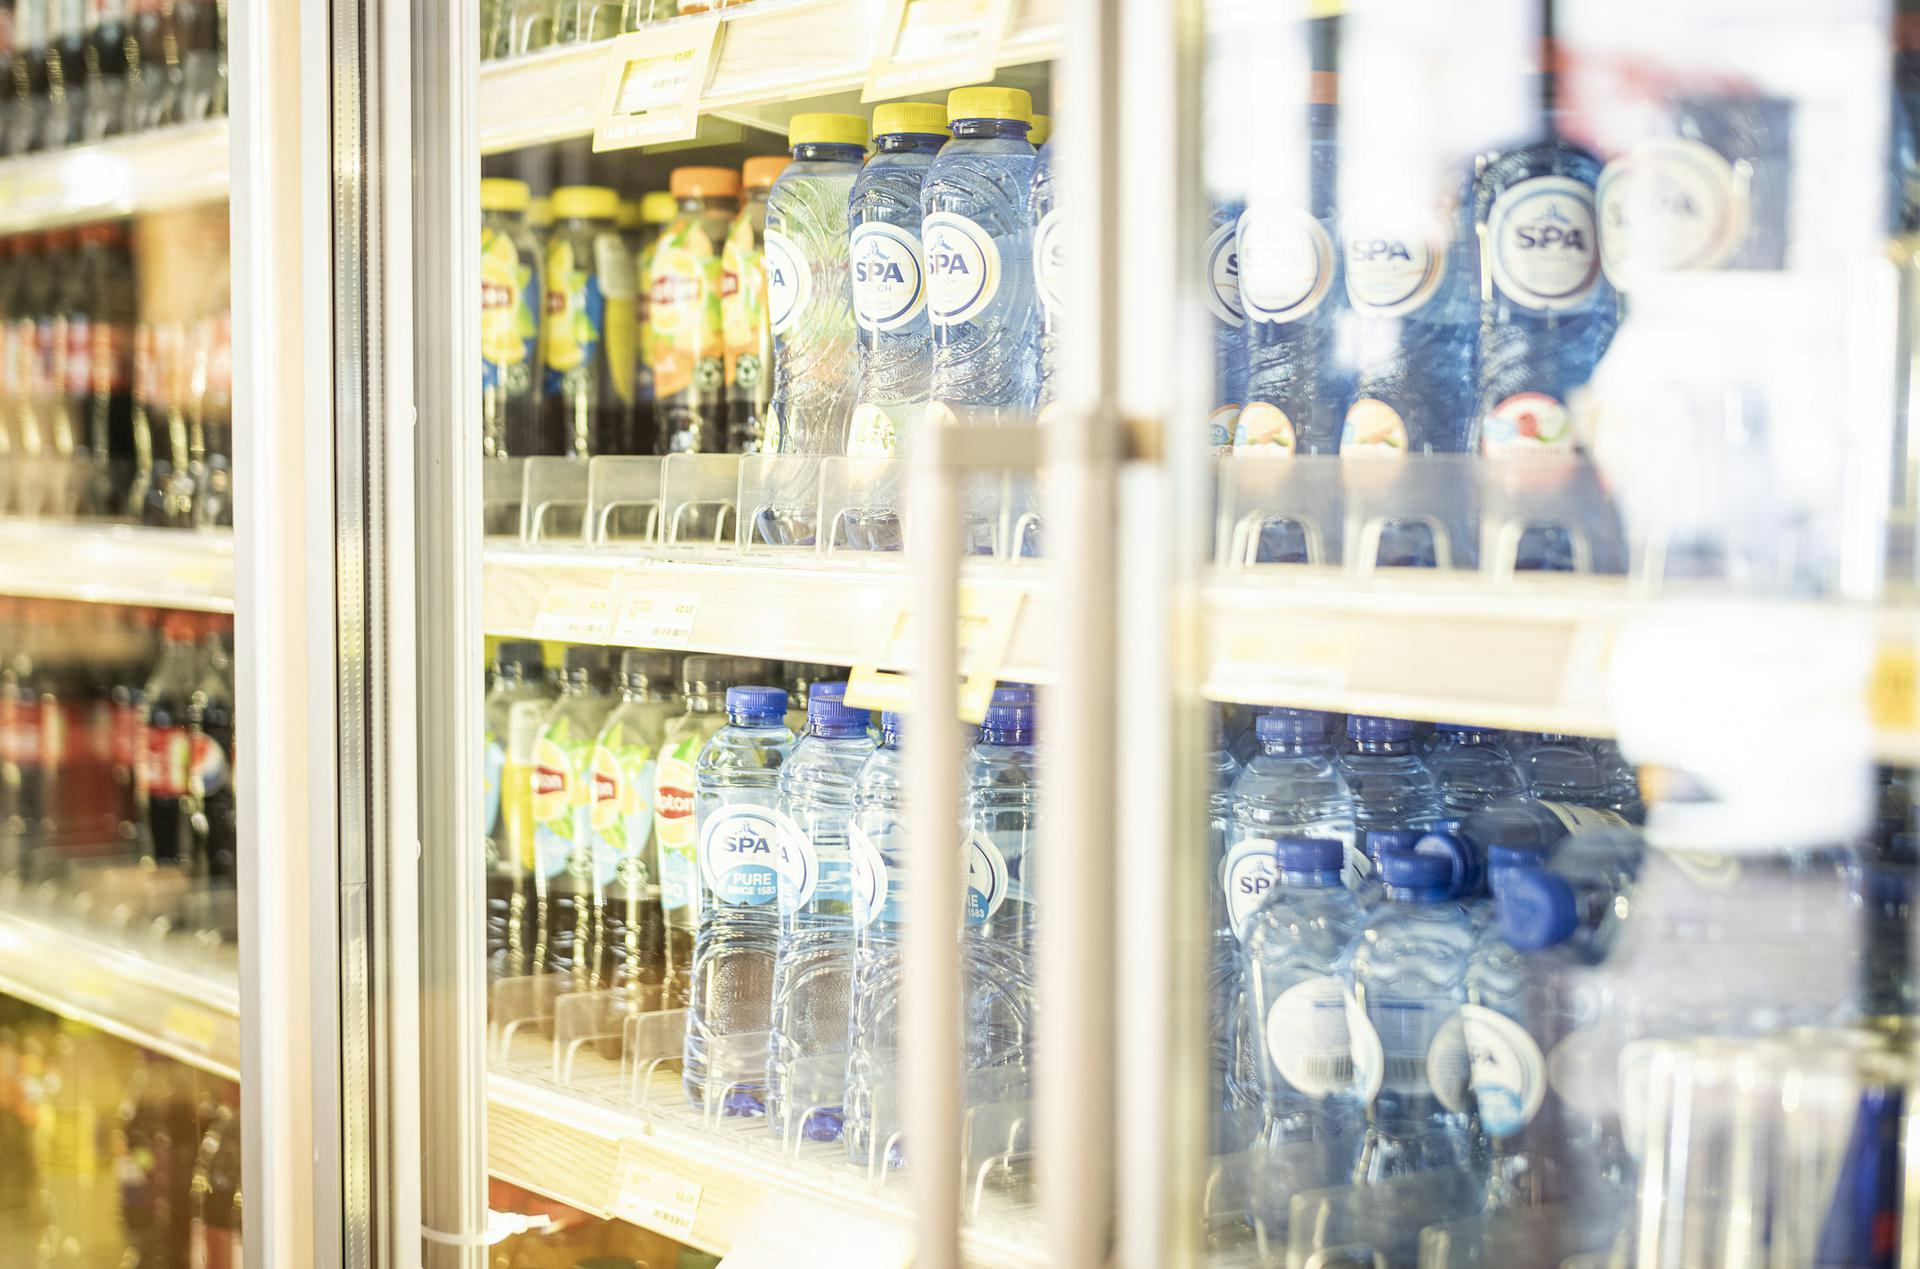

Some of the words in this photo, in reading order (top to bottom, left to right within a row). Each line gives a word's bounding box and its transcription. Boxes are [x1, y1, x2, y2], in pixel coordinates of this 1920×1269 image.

[1514, 224, 1588, 253] SPA
[1352, 239, 1410, 262] SPA
[856, 261, 905, 284] SPA
[723, 836, 771, 854] SPA
[732, 872, 772, 886] PURE
[1240, 877, 1271, 895] SP
[727, 885, 756, 895] SINCE
[757, 885, 777, 896] 1583
